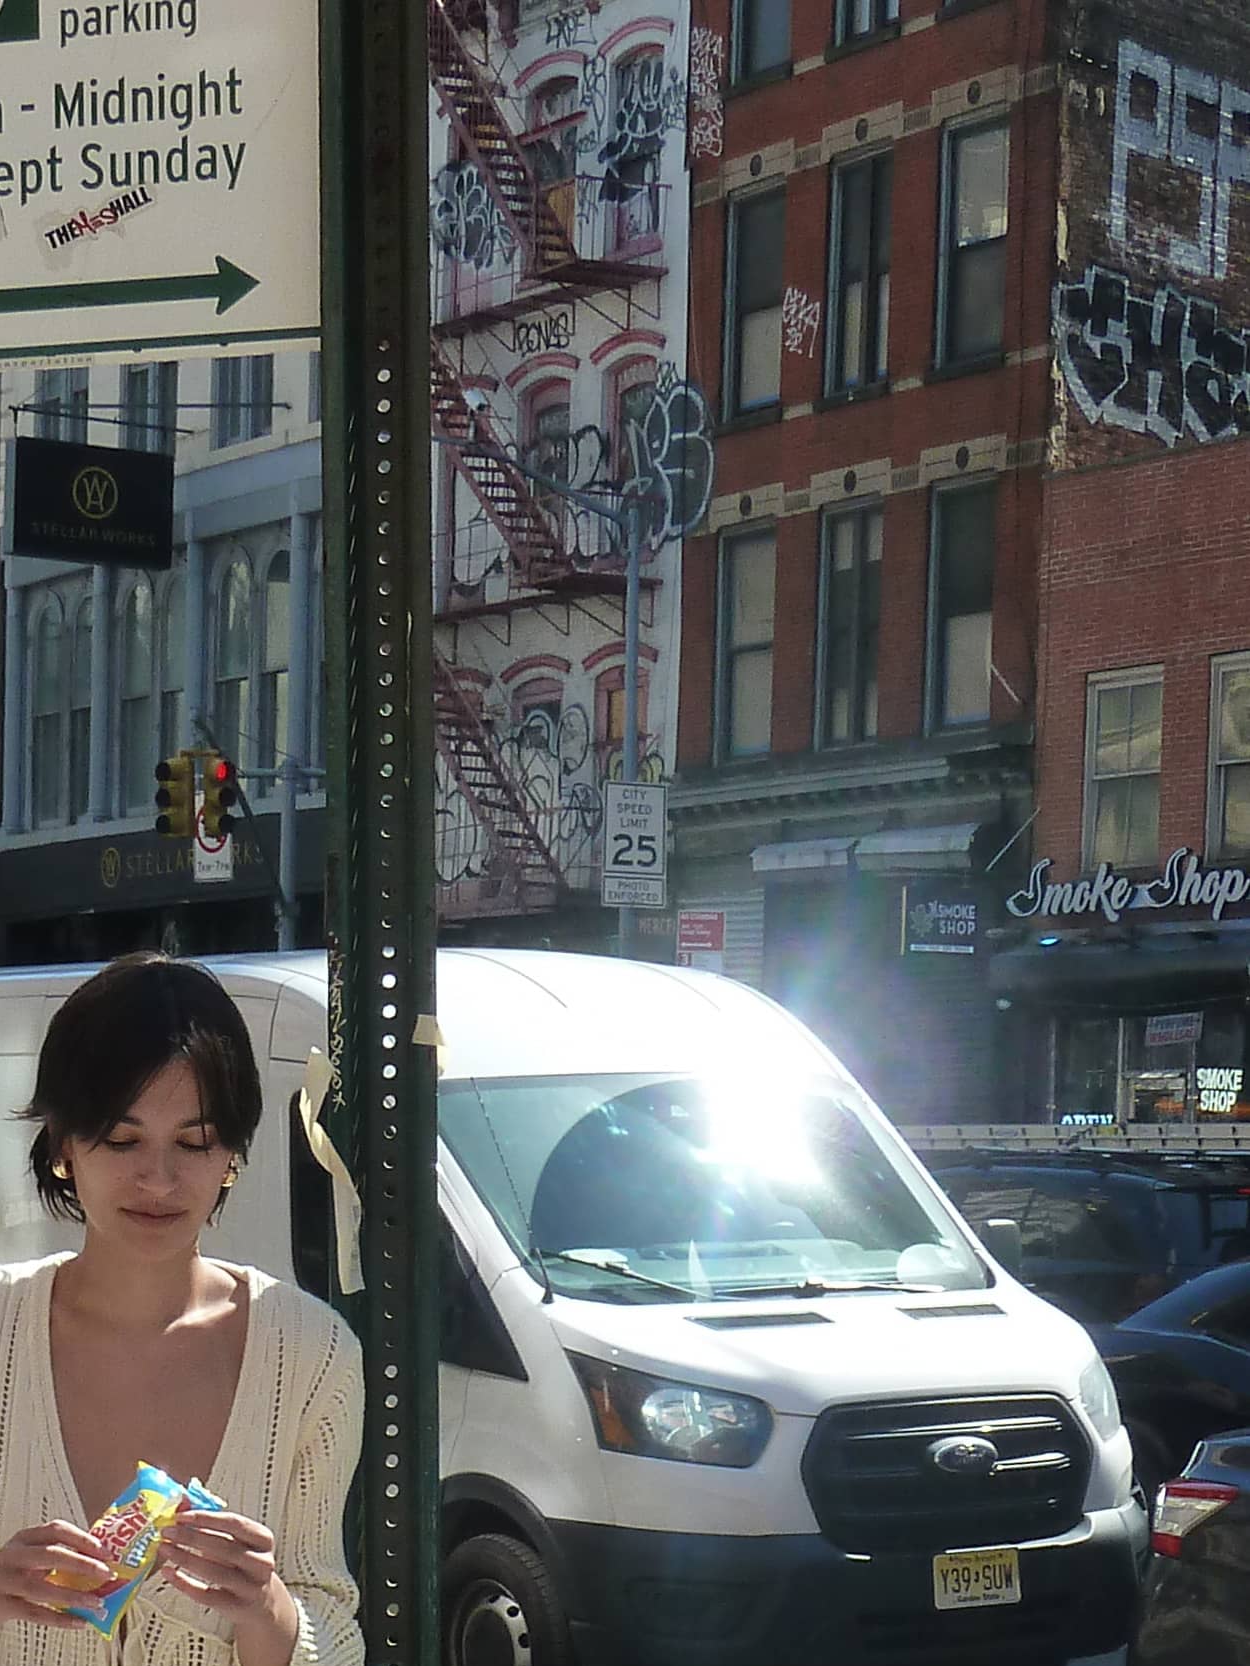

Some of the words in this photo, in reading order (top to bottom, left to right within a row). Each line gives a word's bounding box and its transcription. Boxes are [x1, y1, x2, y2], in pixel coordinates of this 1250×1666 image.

[60, 0, 198, 48] parking
[54, 67, 243, 131] Midnight
[80, 136, 246, 190] Sunday
[621, 788, 647, 800] CITY
[616, 803, 653, 816] SPEED
[620, 818, 649, 830] LIMIT
[612, 833, 657, 868] 25
[617, 880, 650, 890] PHOTO
[1006, 858, 1132, 923] Smoke
[1147, 847, 1250, 921] Shop
[607, 891, 660, 902] ENFORCED
[939, 920, 976, 935] SHOP
[1196, 1068, 1243, 1091] SMOKE
[1200, 1091, 1238, 1113] SHOP
[940, 1565, 971, 1595] Y39
